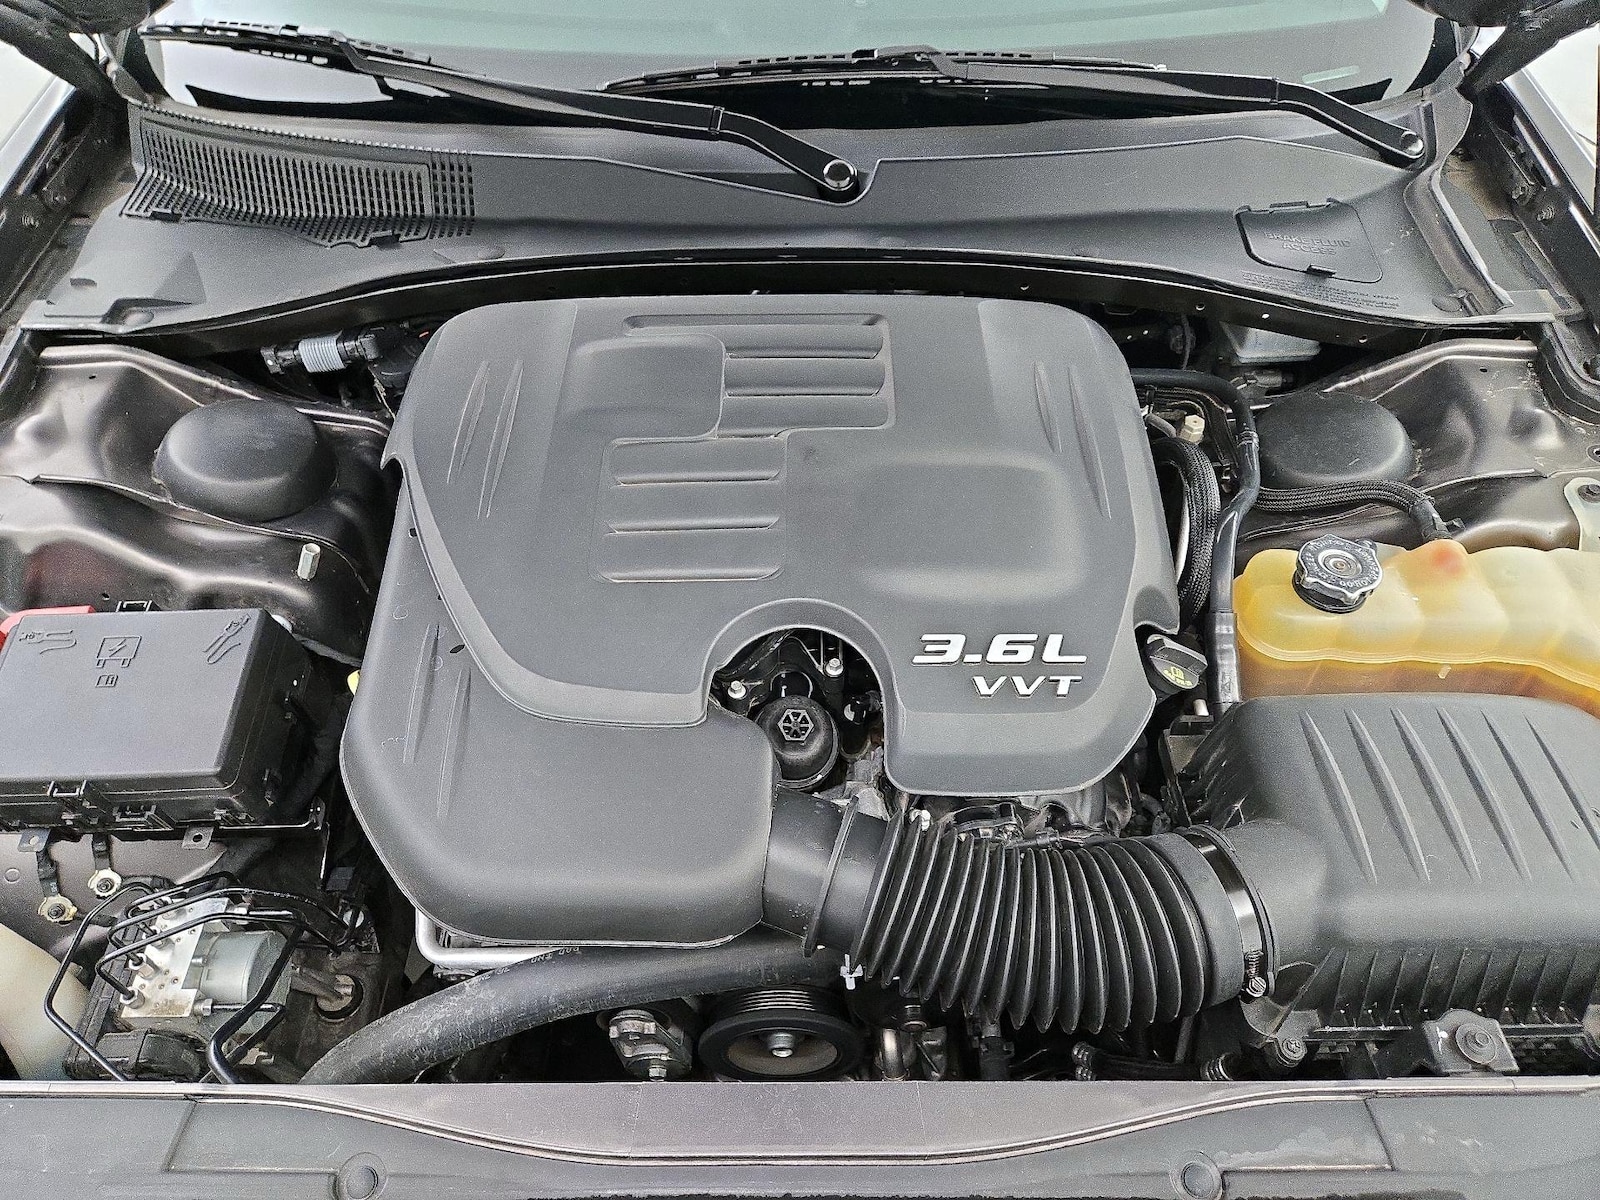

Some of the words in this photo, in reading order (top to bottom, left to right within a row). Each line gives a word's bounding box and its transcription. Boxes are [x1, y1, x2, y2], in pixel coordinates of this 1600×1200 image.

[1264, 231, 1310, 244] BRAKE
[1311, 238, 1351, 248] FLUID
[1282, 242, 1337, 256] ACCESS
[911, 633, 1088, 666] 3.6L
[971, 675, 1083, 698] VVT
